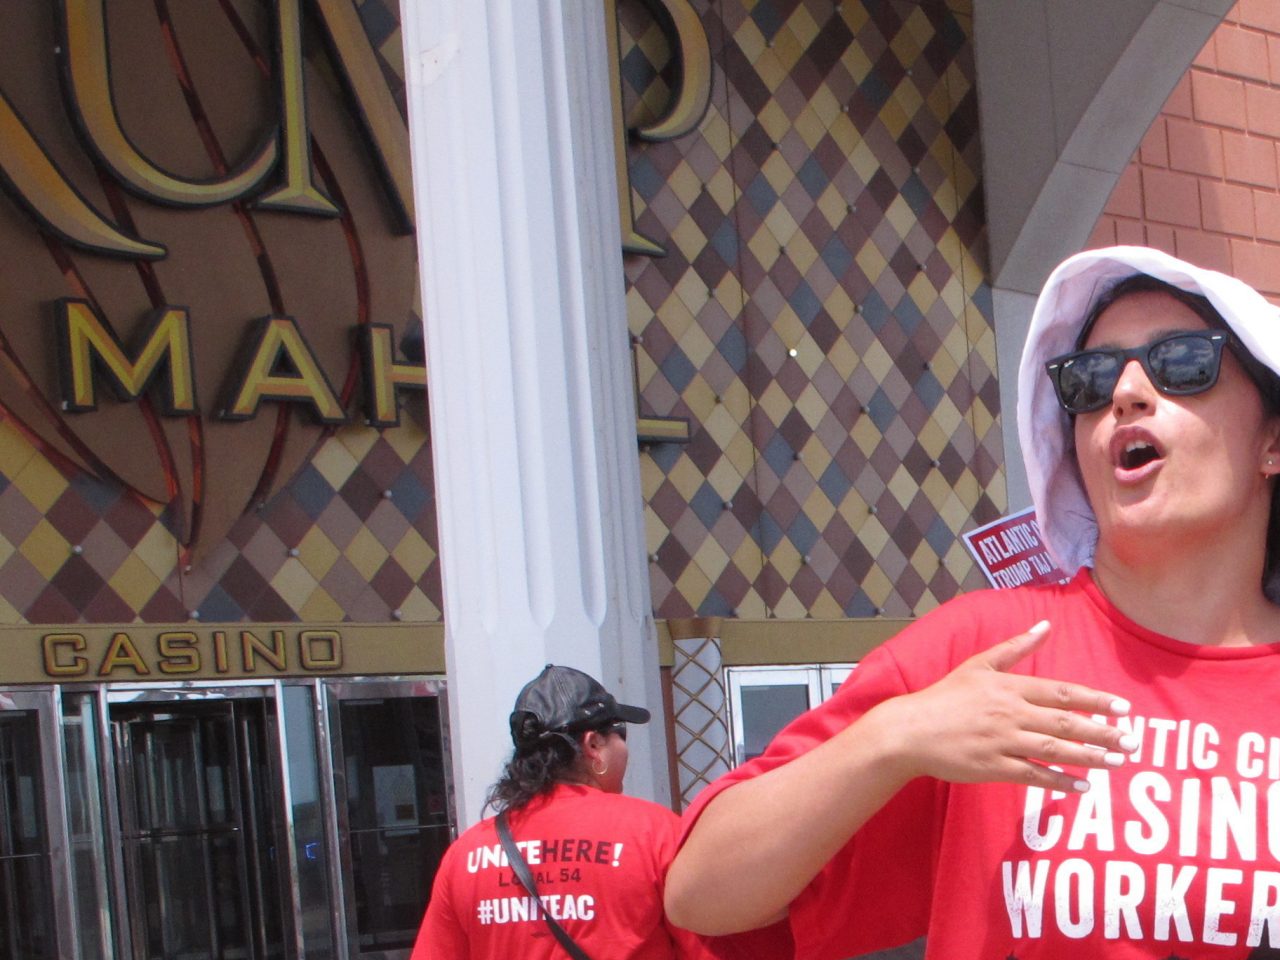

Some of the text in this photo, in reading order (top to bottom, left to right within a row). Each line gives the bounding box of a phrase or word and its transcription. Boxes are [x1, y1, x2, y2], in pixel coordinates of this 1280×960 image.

[978, 523, 1039, 566] ATLANTIC
[992, 560, 1034, 589] TRUMP
[41, 630, 344, 676] CASINO
[498, 867, 582, 888] LOAL 54
[477, 894, 595, 925] #UNITEAC
